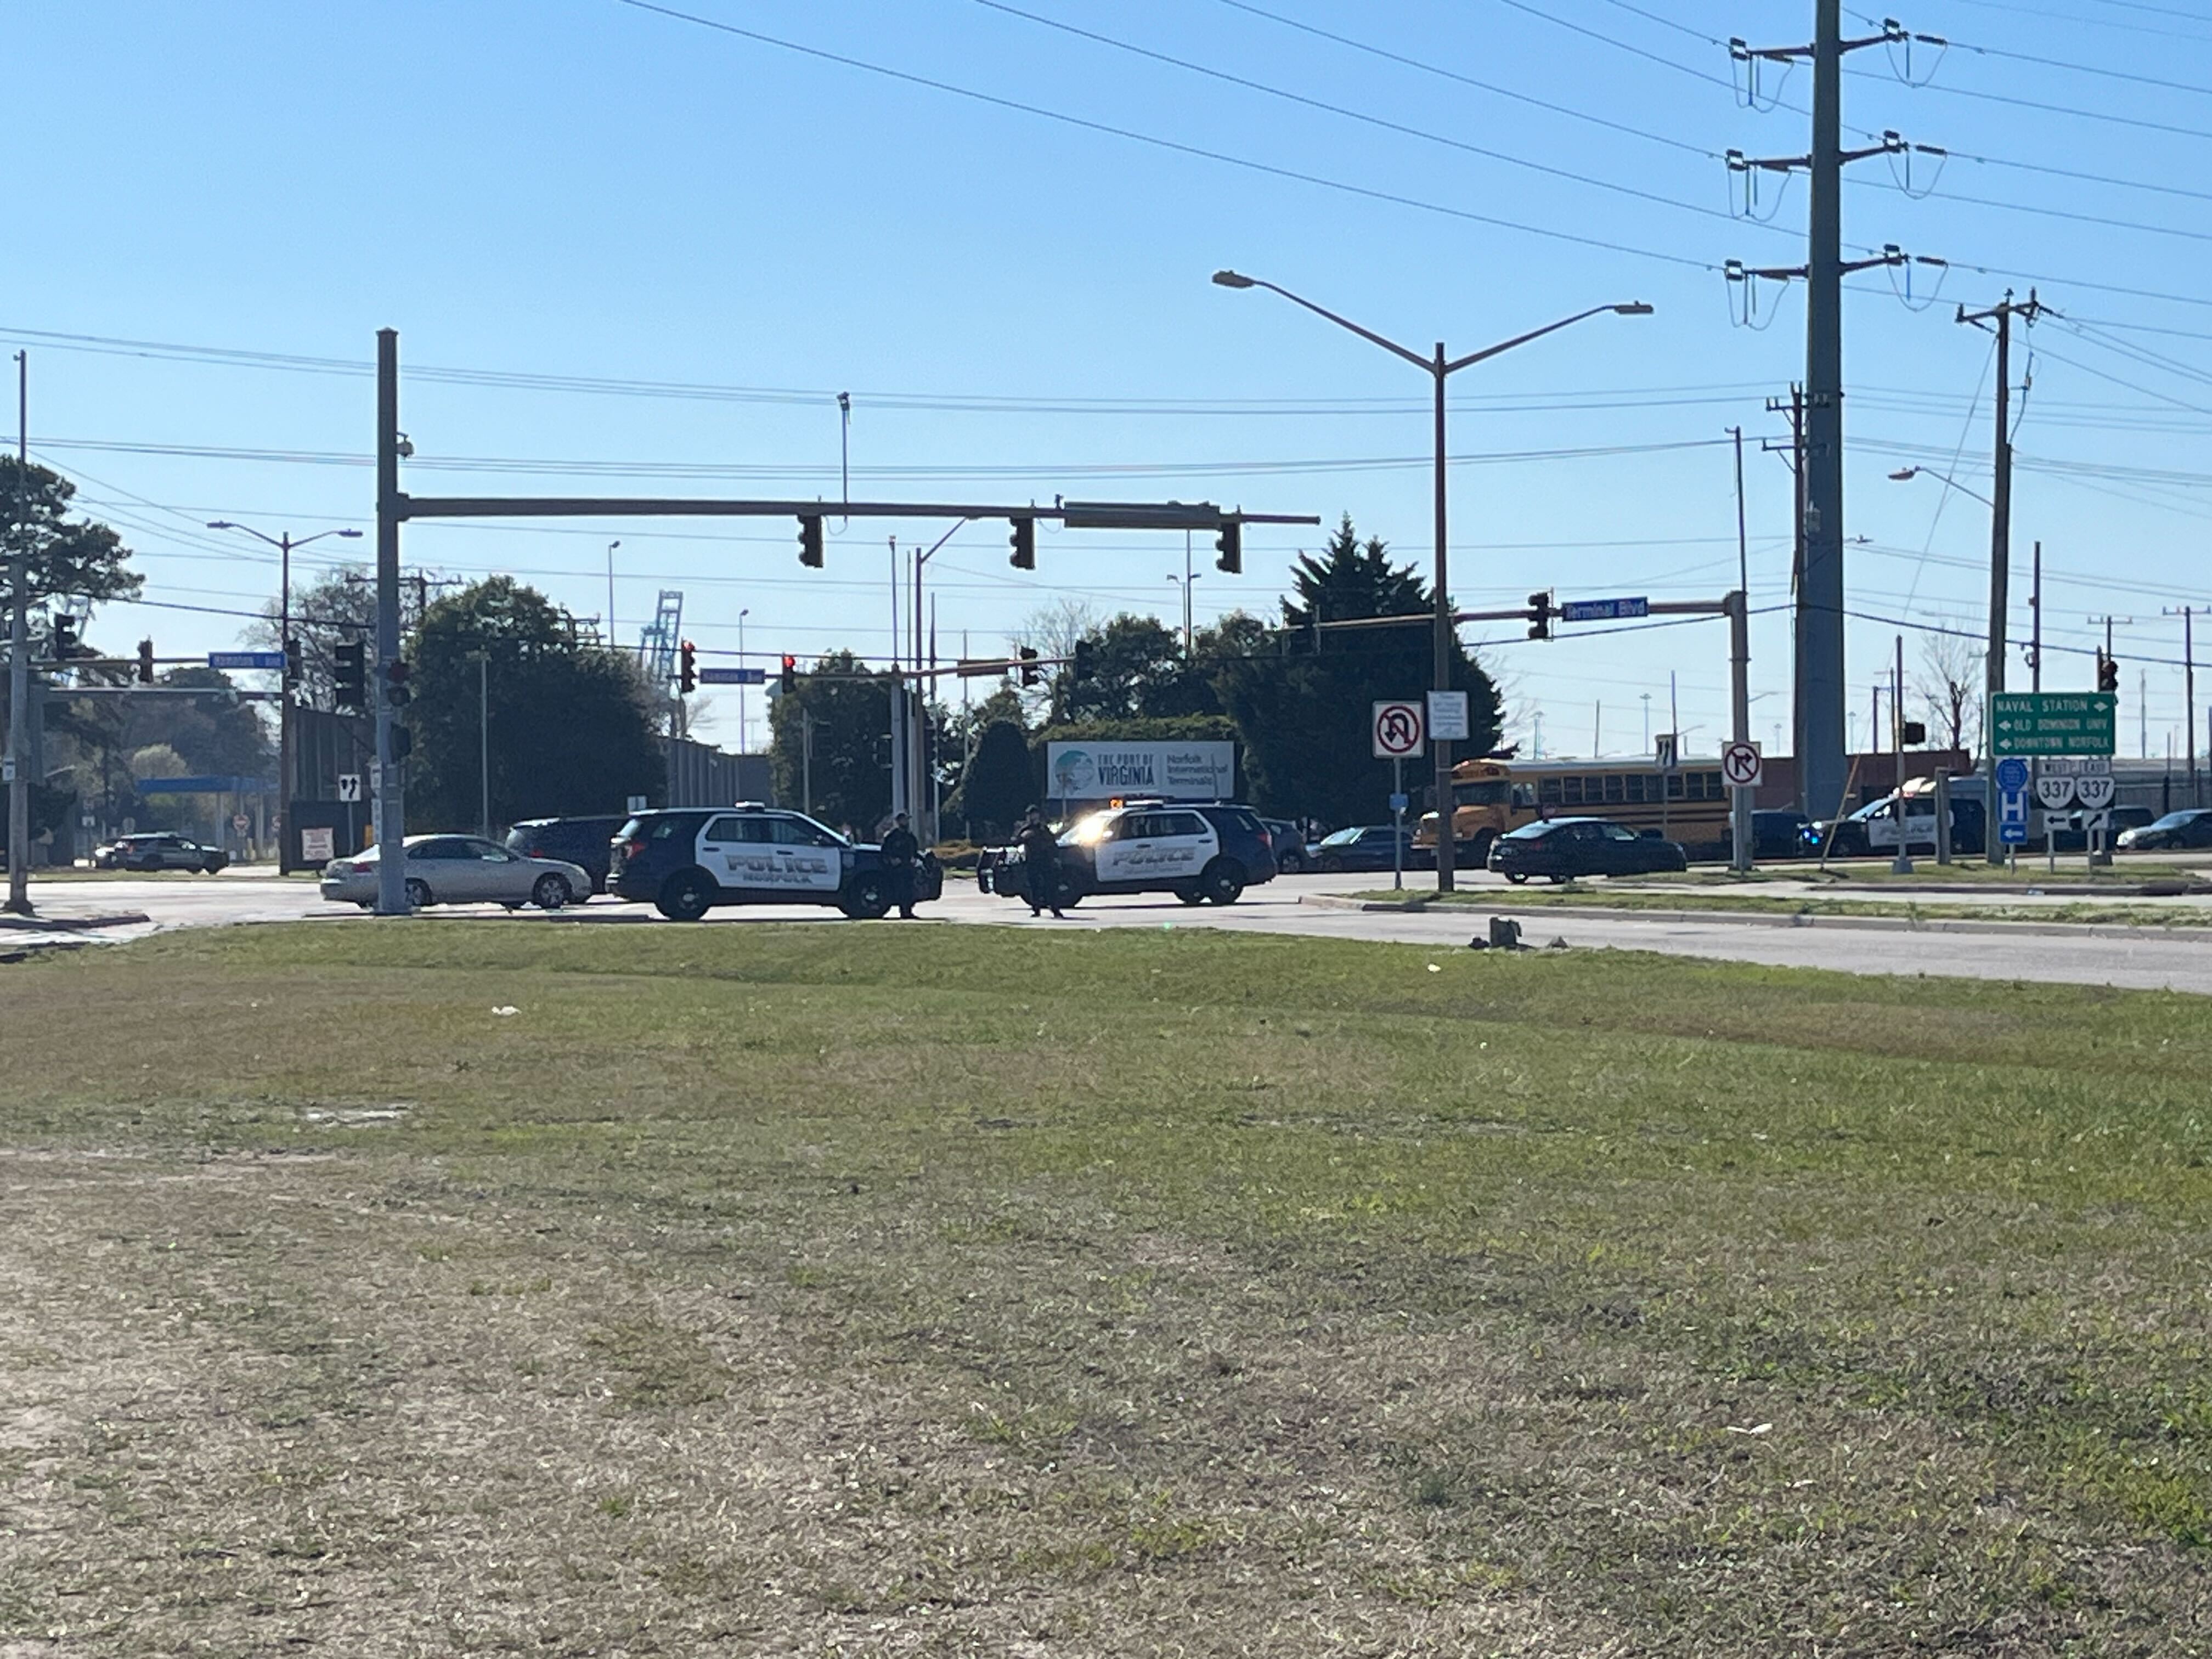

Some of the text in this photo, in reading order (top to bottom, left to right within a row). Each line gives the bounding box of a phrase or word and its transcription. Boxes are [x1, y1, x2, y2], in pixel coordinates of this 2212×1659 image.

[1566, 601, 1645, 619] Terminal Blvd
[1996, 699, 2088, 713] NAVAL STATION
[2013, 718, 2032, 732] OLD
[2068, 736, 2109, 749] NORFOLK
[1118, 753, 1141, 765] PORT
[1143, 753, 1154, 765] OF
[1167, 753, 1202, 764] Norfolk
[1098, 765, 1155, 786] VIRGINIA
[2042, 781, 2071, 799] 337
[2081, 780, 2110, 799] 337
[2002, 792, 2024, 821] H
[725, 854, 828, 874] POLICE
[1113, 847, 1196, 866] POLICE
